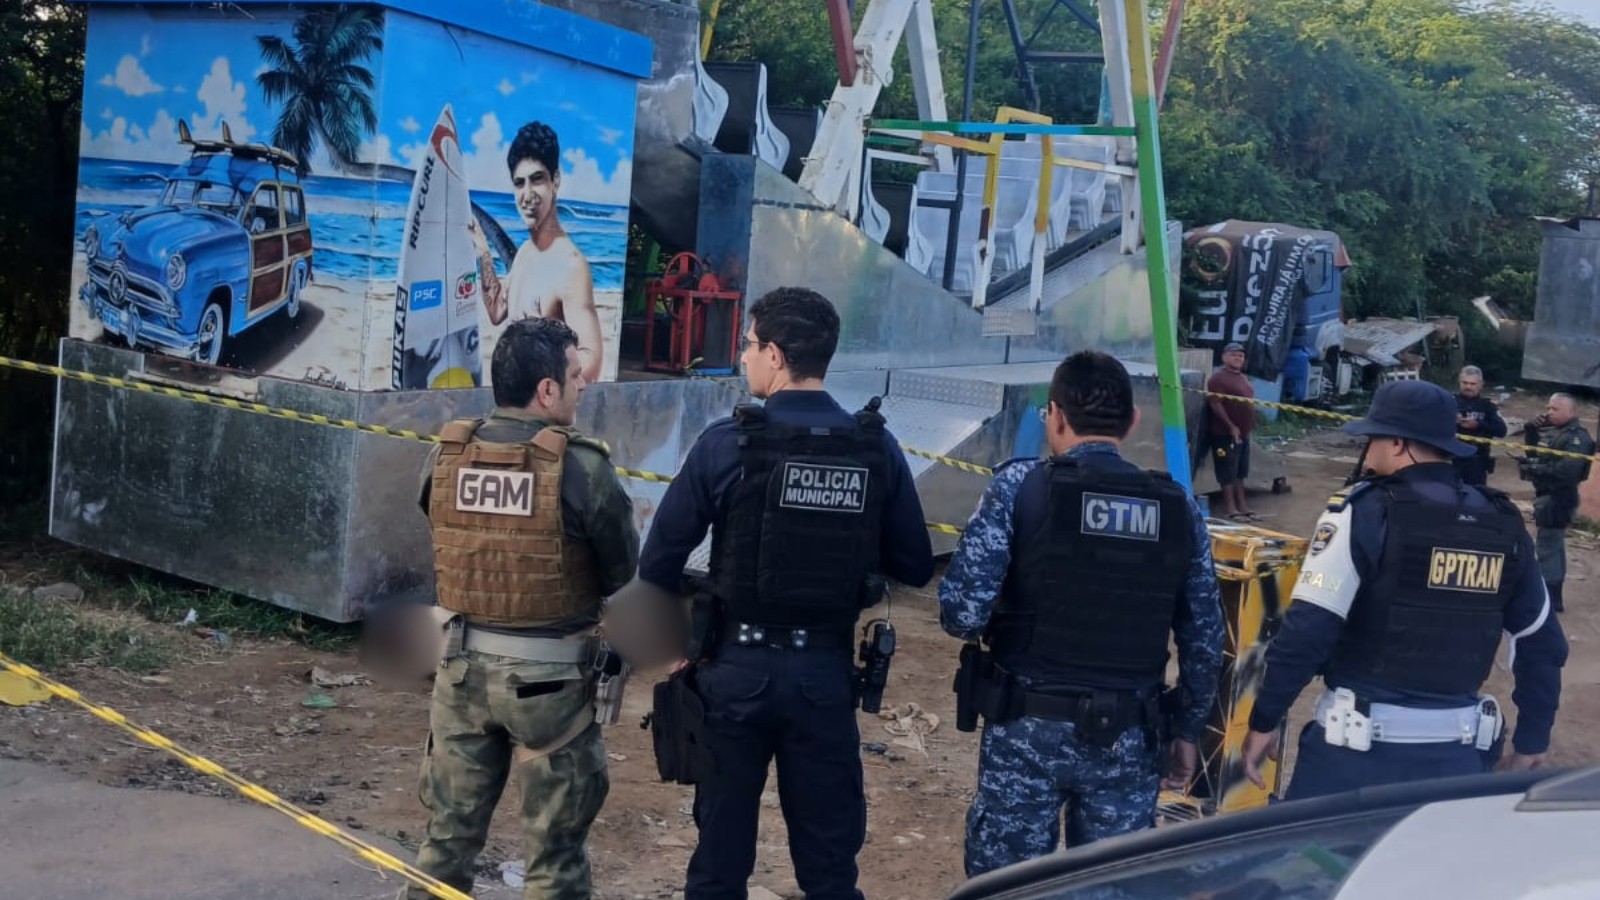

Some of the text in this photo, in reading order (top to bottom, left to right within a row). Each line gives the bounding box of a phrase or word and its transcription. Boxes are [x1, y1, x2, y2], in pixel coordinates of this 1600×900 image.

[1189, 290, 1227, 340] Eu
[392, 286, 408, 390] PUKAS
[460, 473, 531, 510] GAM
[785, 487, 862, 507] MUNICIPAL
[788, 467, 862, 491] POLICIA
[1086, 499, 1157, 535] GTM
[1431, 551, 1503, 588] GPTRAN
